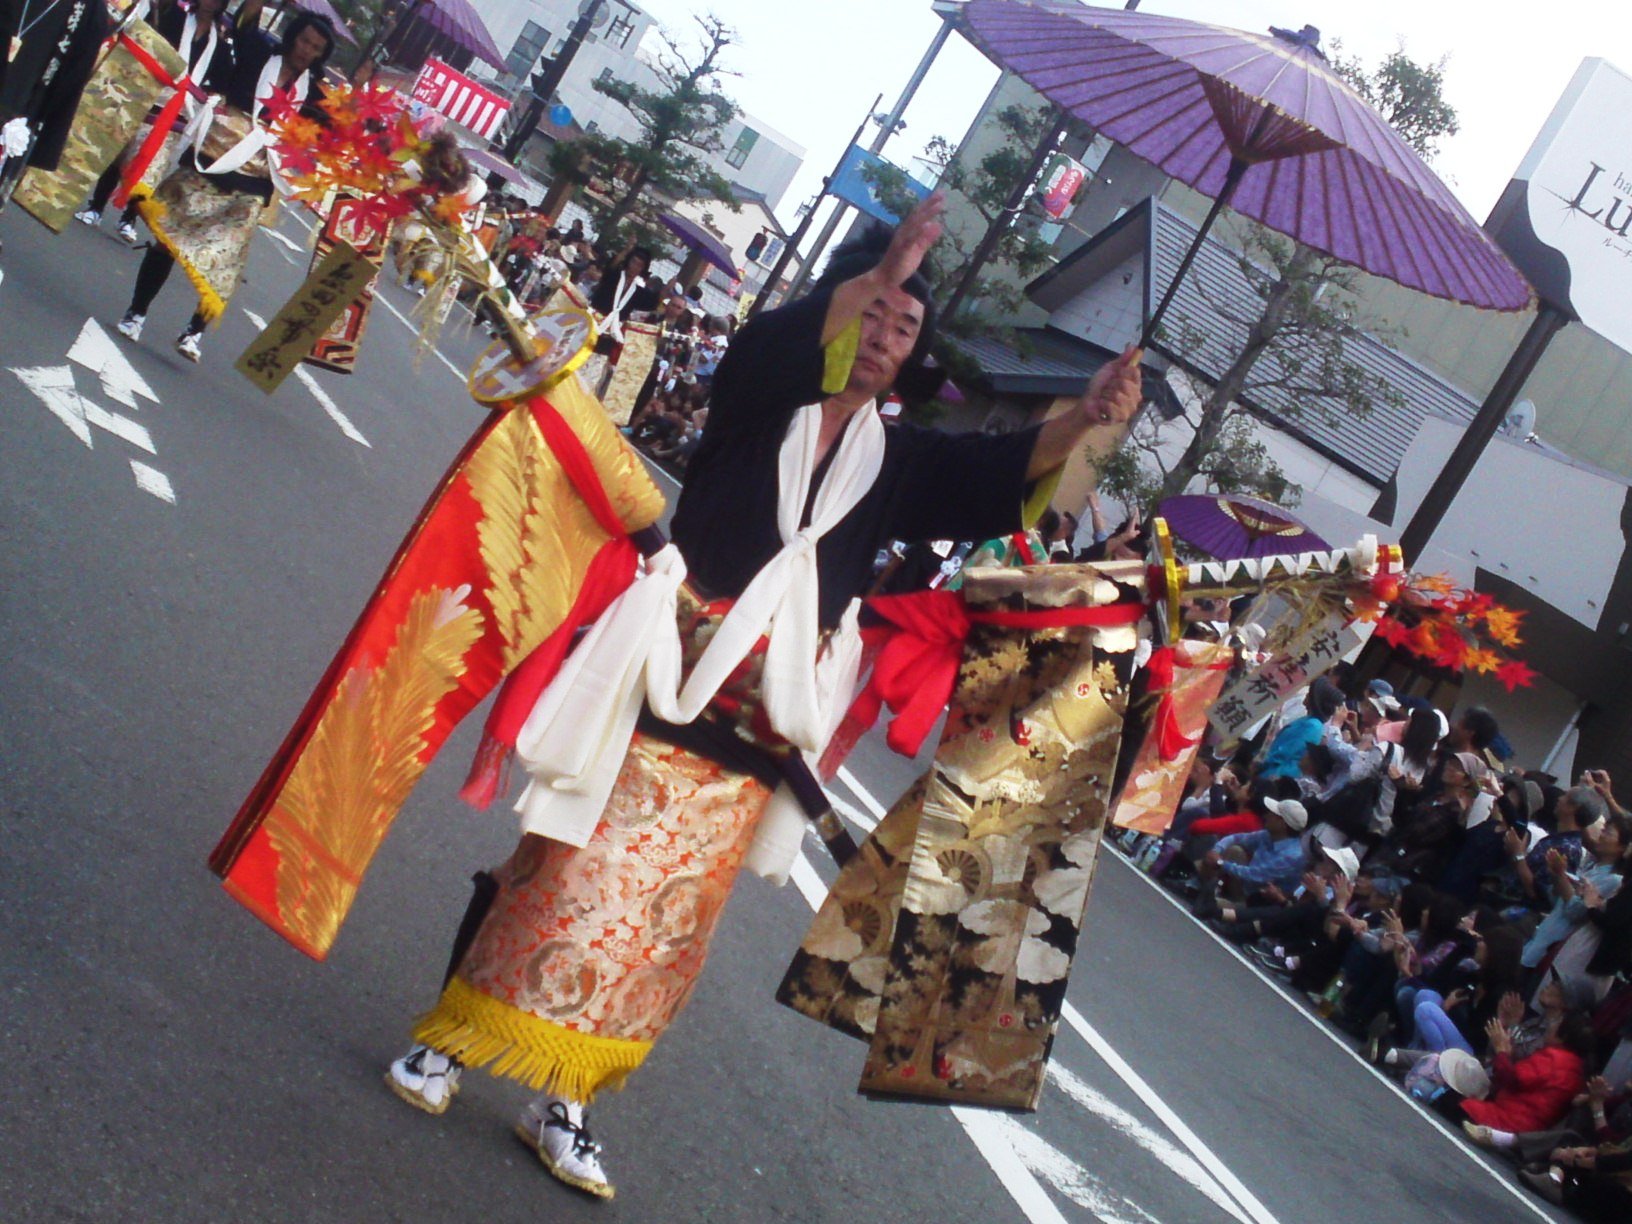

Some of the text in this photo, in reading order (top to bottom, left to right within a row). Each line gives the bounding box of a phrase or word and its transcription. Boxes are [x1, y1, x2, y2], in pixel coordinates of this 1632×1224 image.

[1570, 160, 1632, 237] Lu
[1214, 630, 1341, 733] 安産祈願
